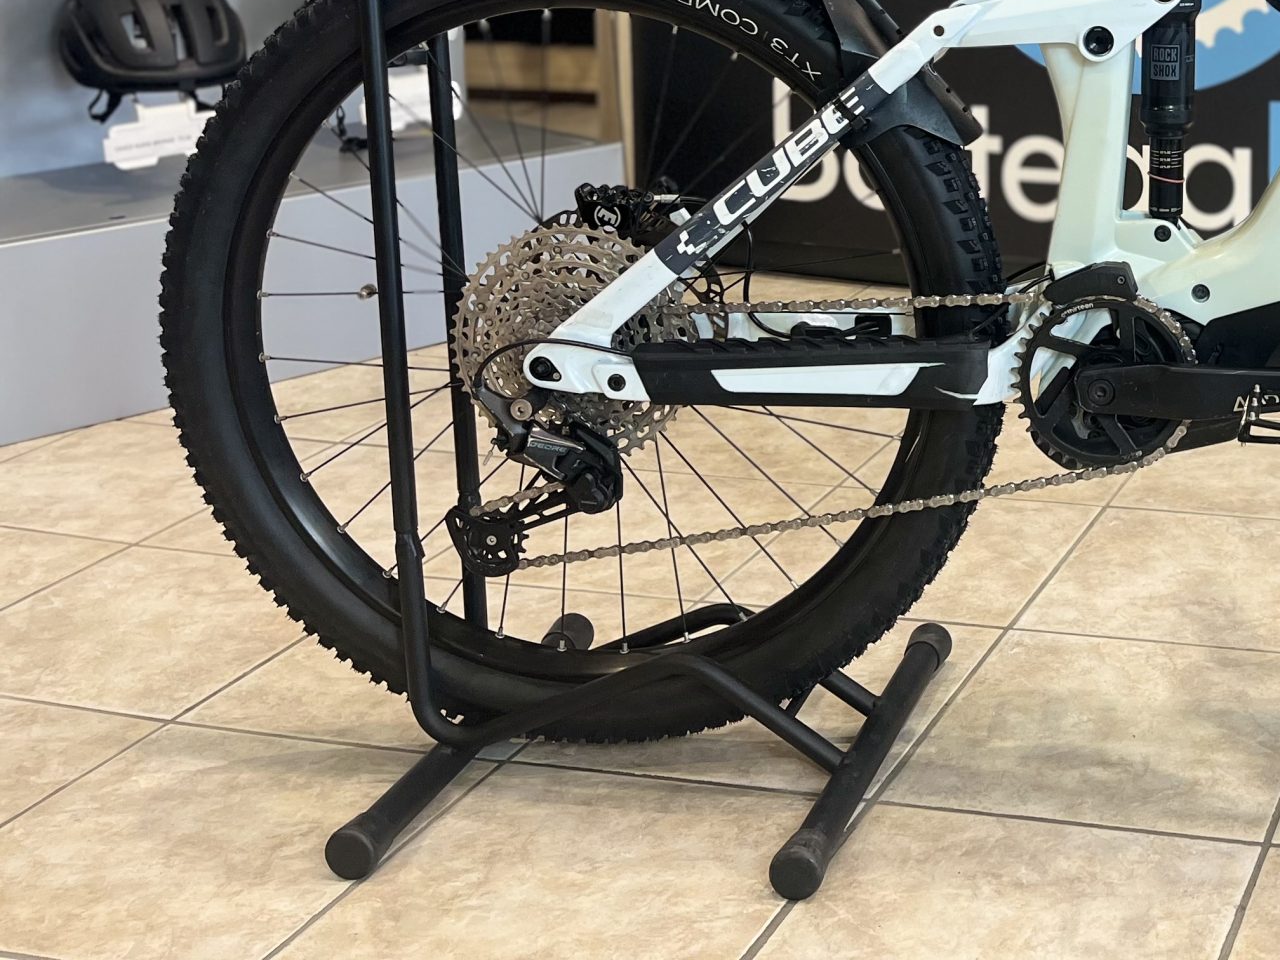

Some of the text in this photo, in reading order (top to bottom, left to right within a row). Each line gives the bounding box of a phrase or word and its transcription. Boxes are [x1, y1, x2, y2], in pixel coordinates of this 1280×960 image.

[1153, 47, 1177, 62] ROCK
[1153, 63, 1177, 77] SHOX
[713, 86, 866, 225] CUBE
